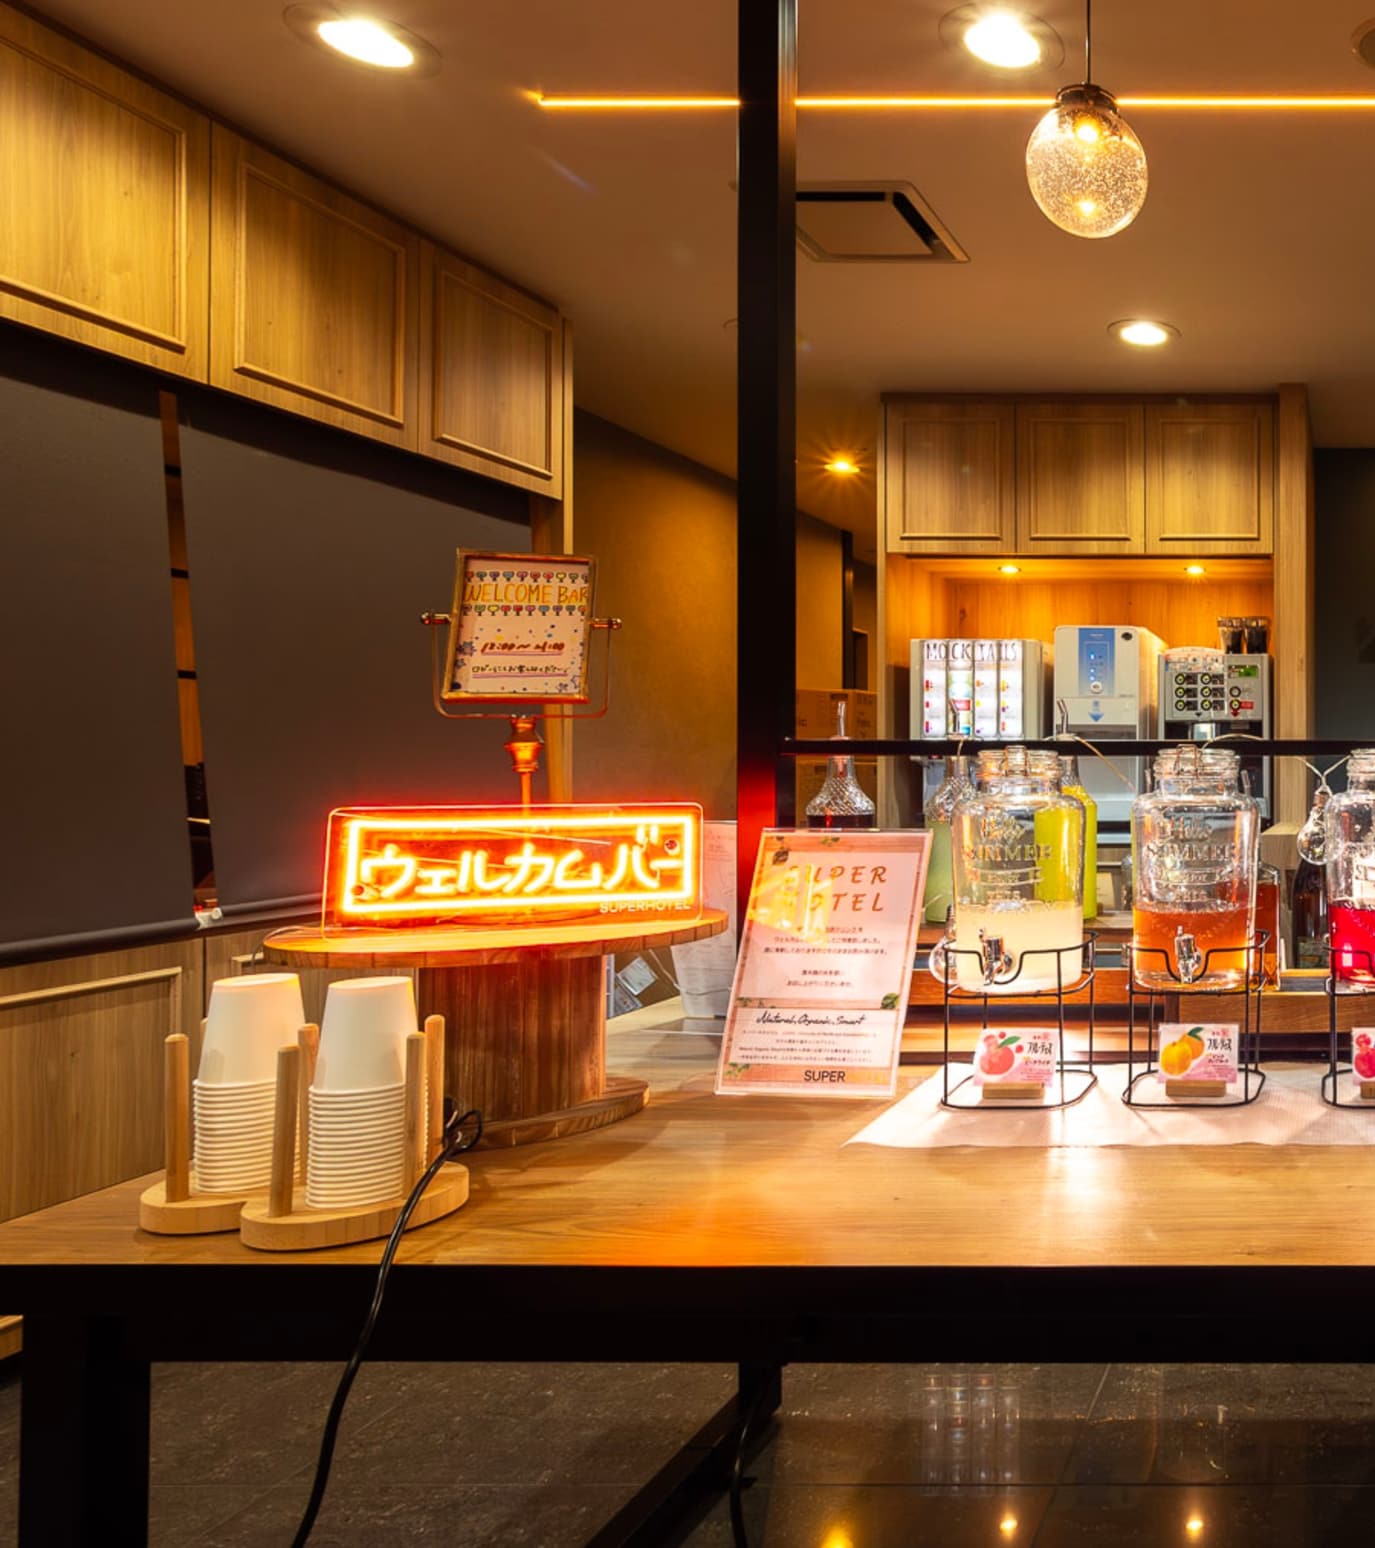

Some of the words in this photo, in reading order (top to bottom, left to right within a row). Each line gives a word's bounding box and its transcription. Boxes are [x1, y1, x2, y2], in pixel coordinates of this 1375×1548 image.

[465, 583, 553, 602] WELCOME
[558, 586, 588, 602] BAR
[361, 825, 684, 897] ウェルカムバー
[600, 901, 691, 913] SUPERHOTEL
[804, 1070, 846, 1082] SUPER
